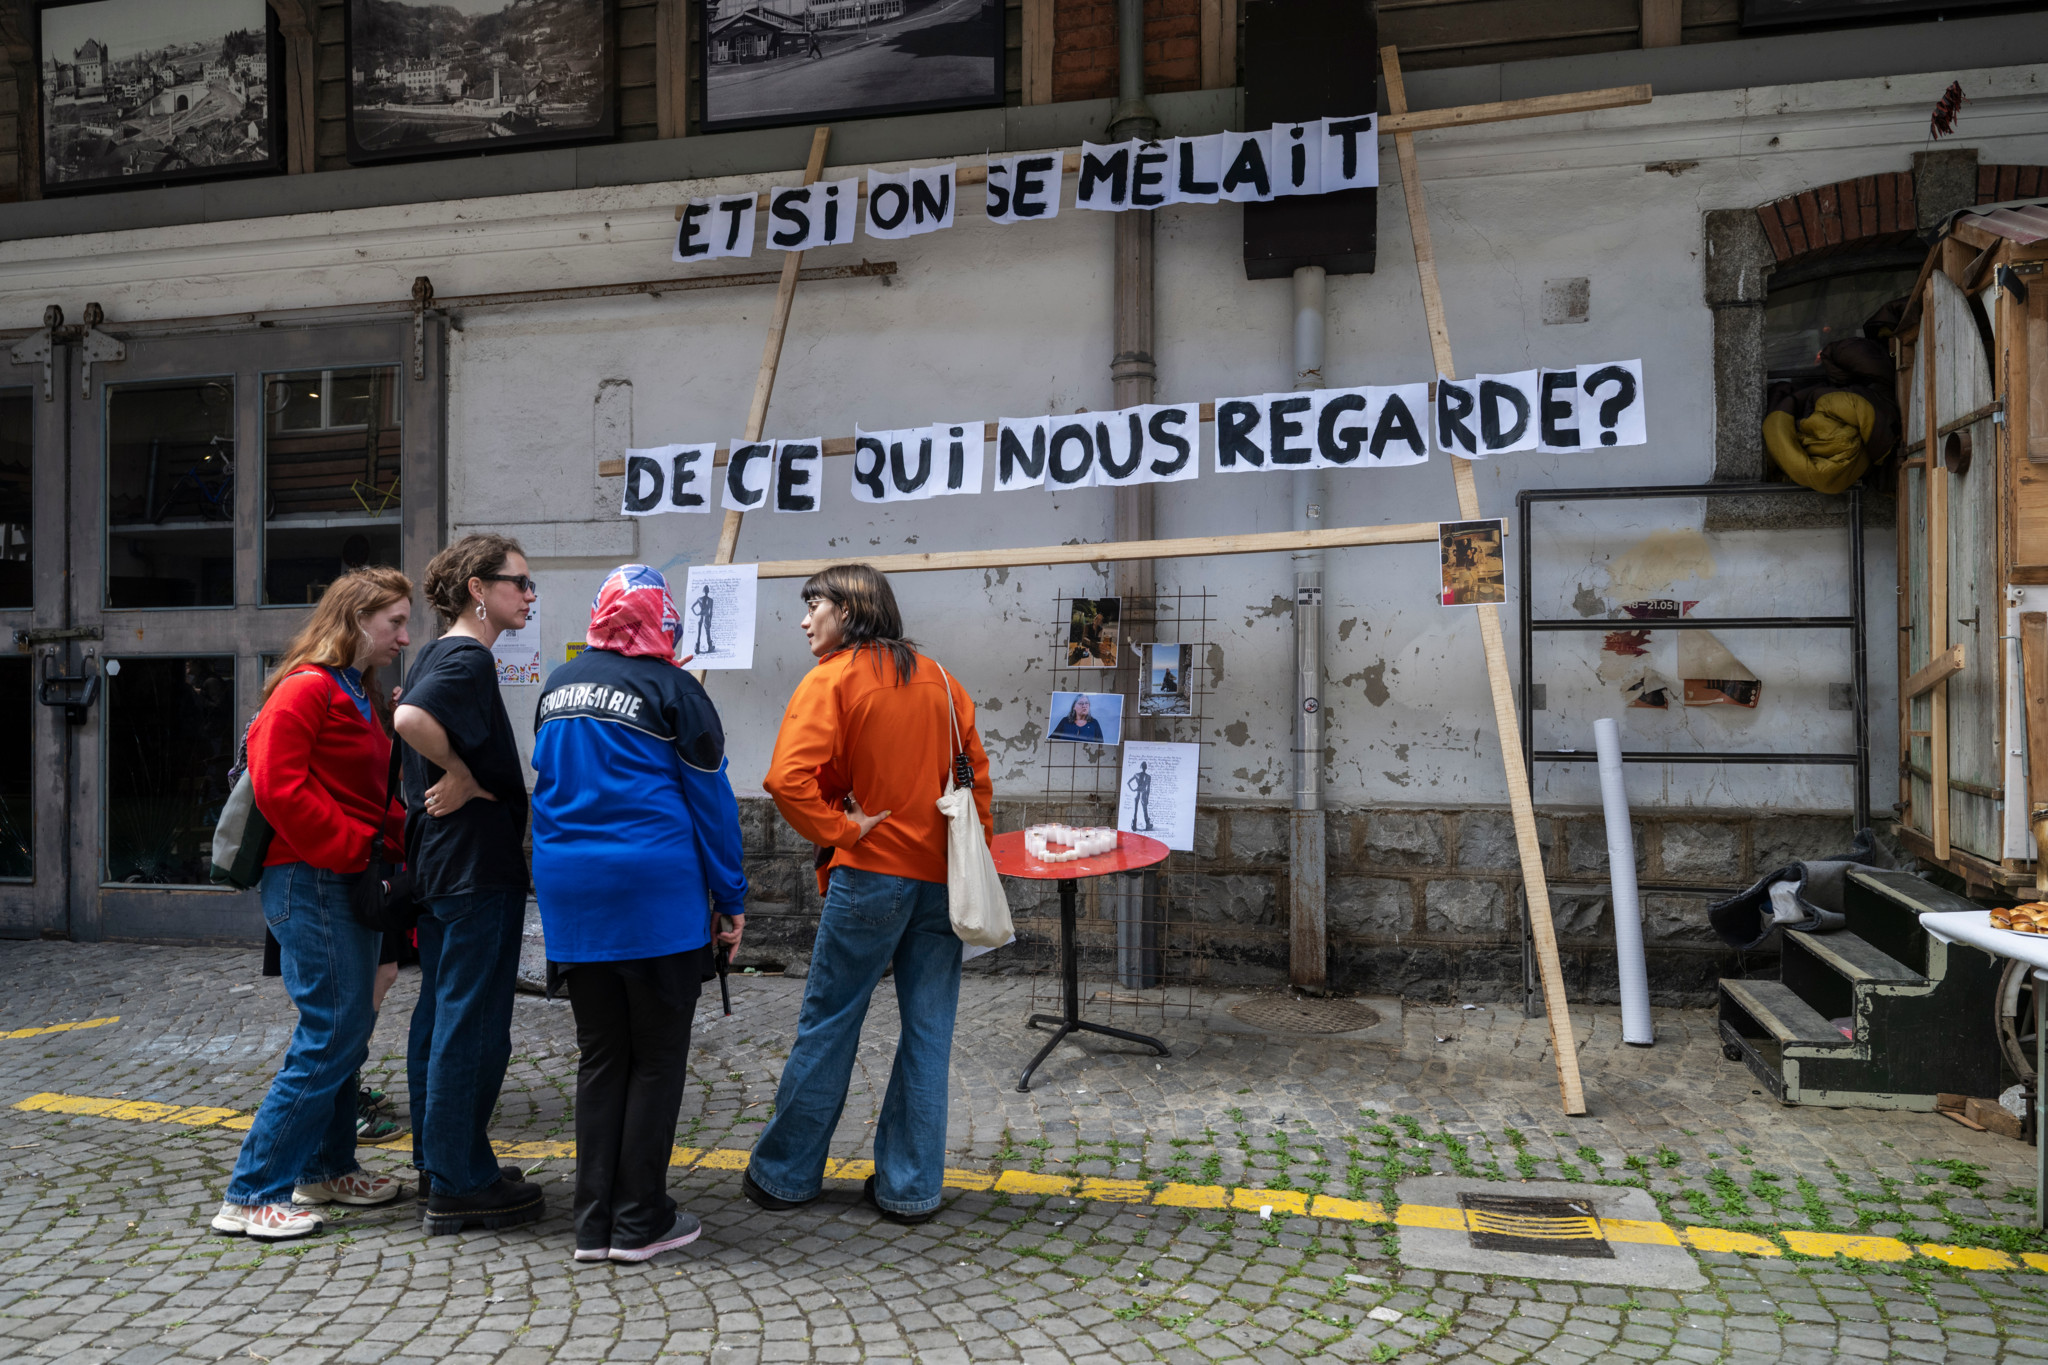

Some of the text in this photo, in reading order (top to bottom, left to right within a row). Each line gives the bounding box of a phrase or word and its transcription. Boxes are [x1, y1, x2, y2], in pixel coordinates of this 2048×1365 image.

[679, 198, 752, 257] ET
[869, 174, 949, 230] ON
[987, 156, 1056, 218] SE
[624, 449, 705, 512] DE
[727, 444, 819, 511] CE
[999, 408, 1191, 484] NOUS
[1217, 365, 1637, 467] REGARDE?
